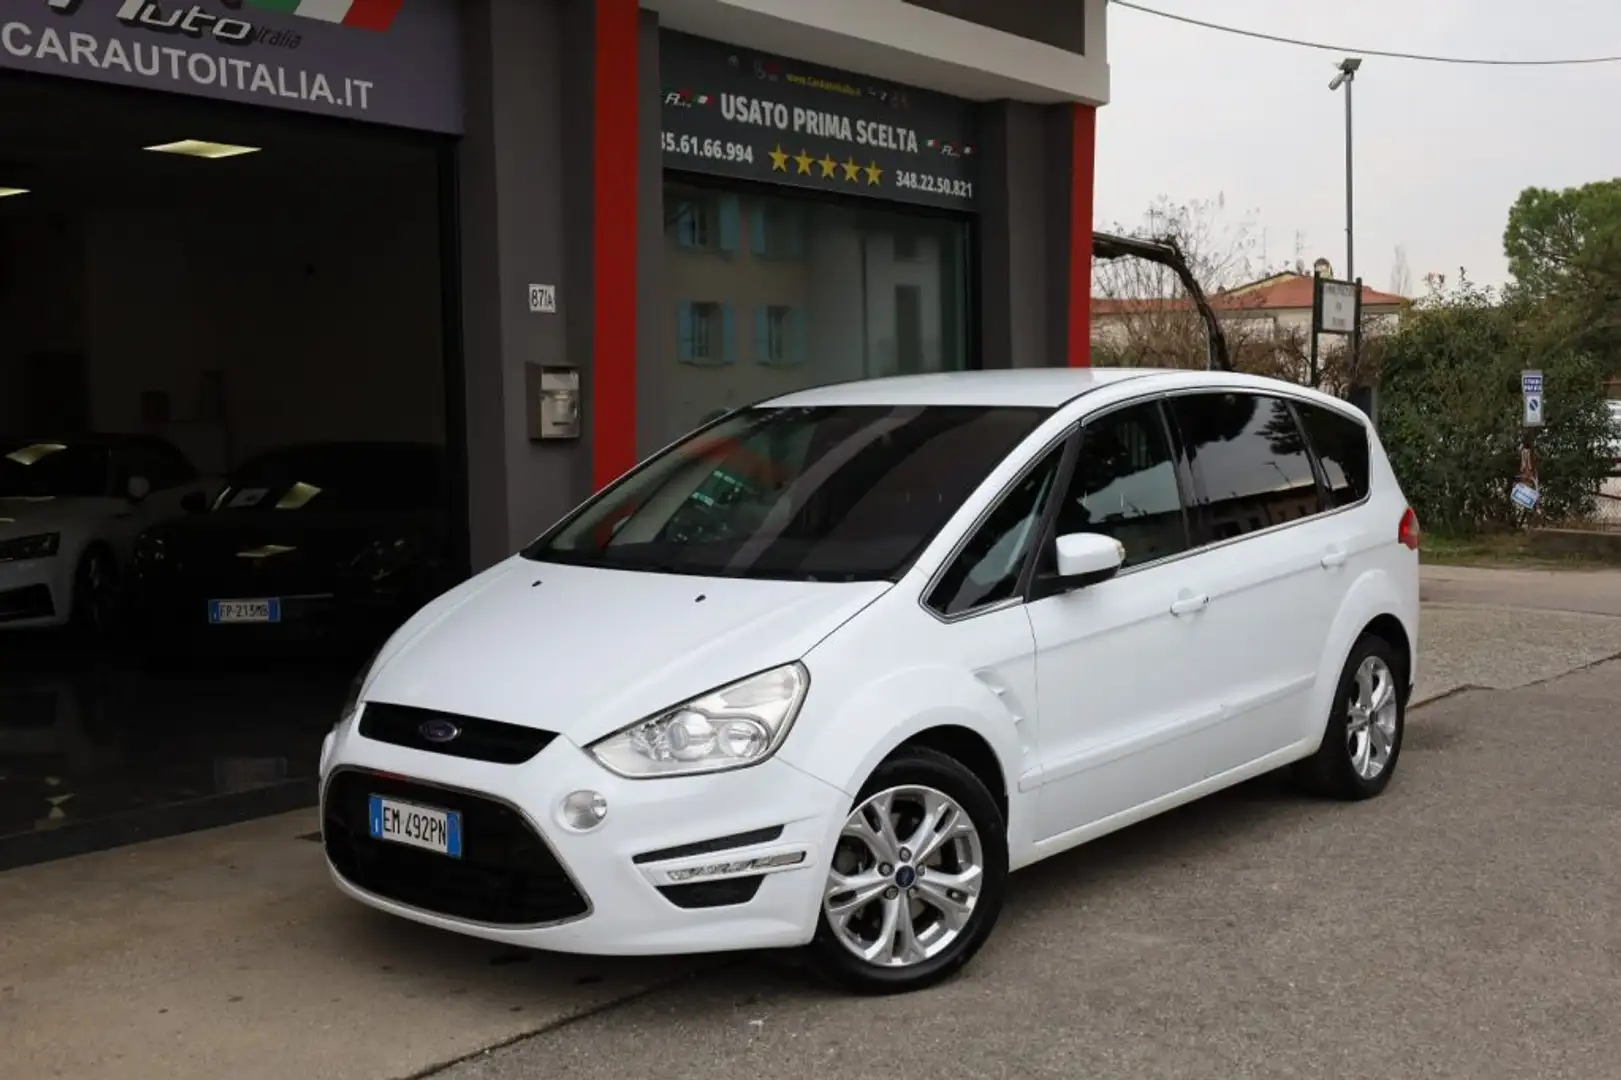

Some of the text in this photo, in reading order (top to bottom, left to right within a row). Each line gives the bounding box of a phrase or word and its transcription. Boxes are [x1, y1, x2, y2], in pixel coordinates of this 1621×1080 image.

[1, 21, 373, 110] CARAUTOITALIA.IT
[720, 93, 789, 130] USATO
[793, 107, 852, 142] PRIMA
[855, 119, 919, 153] SCELTA
[895, 170, 973, 198] 348.22.50.821
[383, 806, 446, 845] EM 492PN
